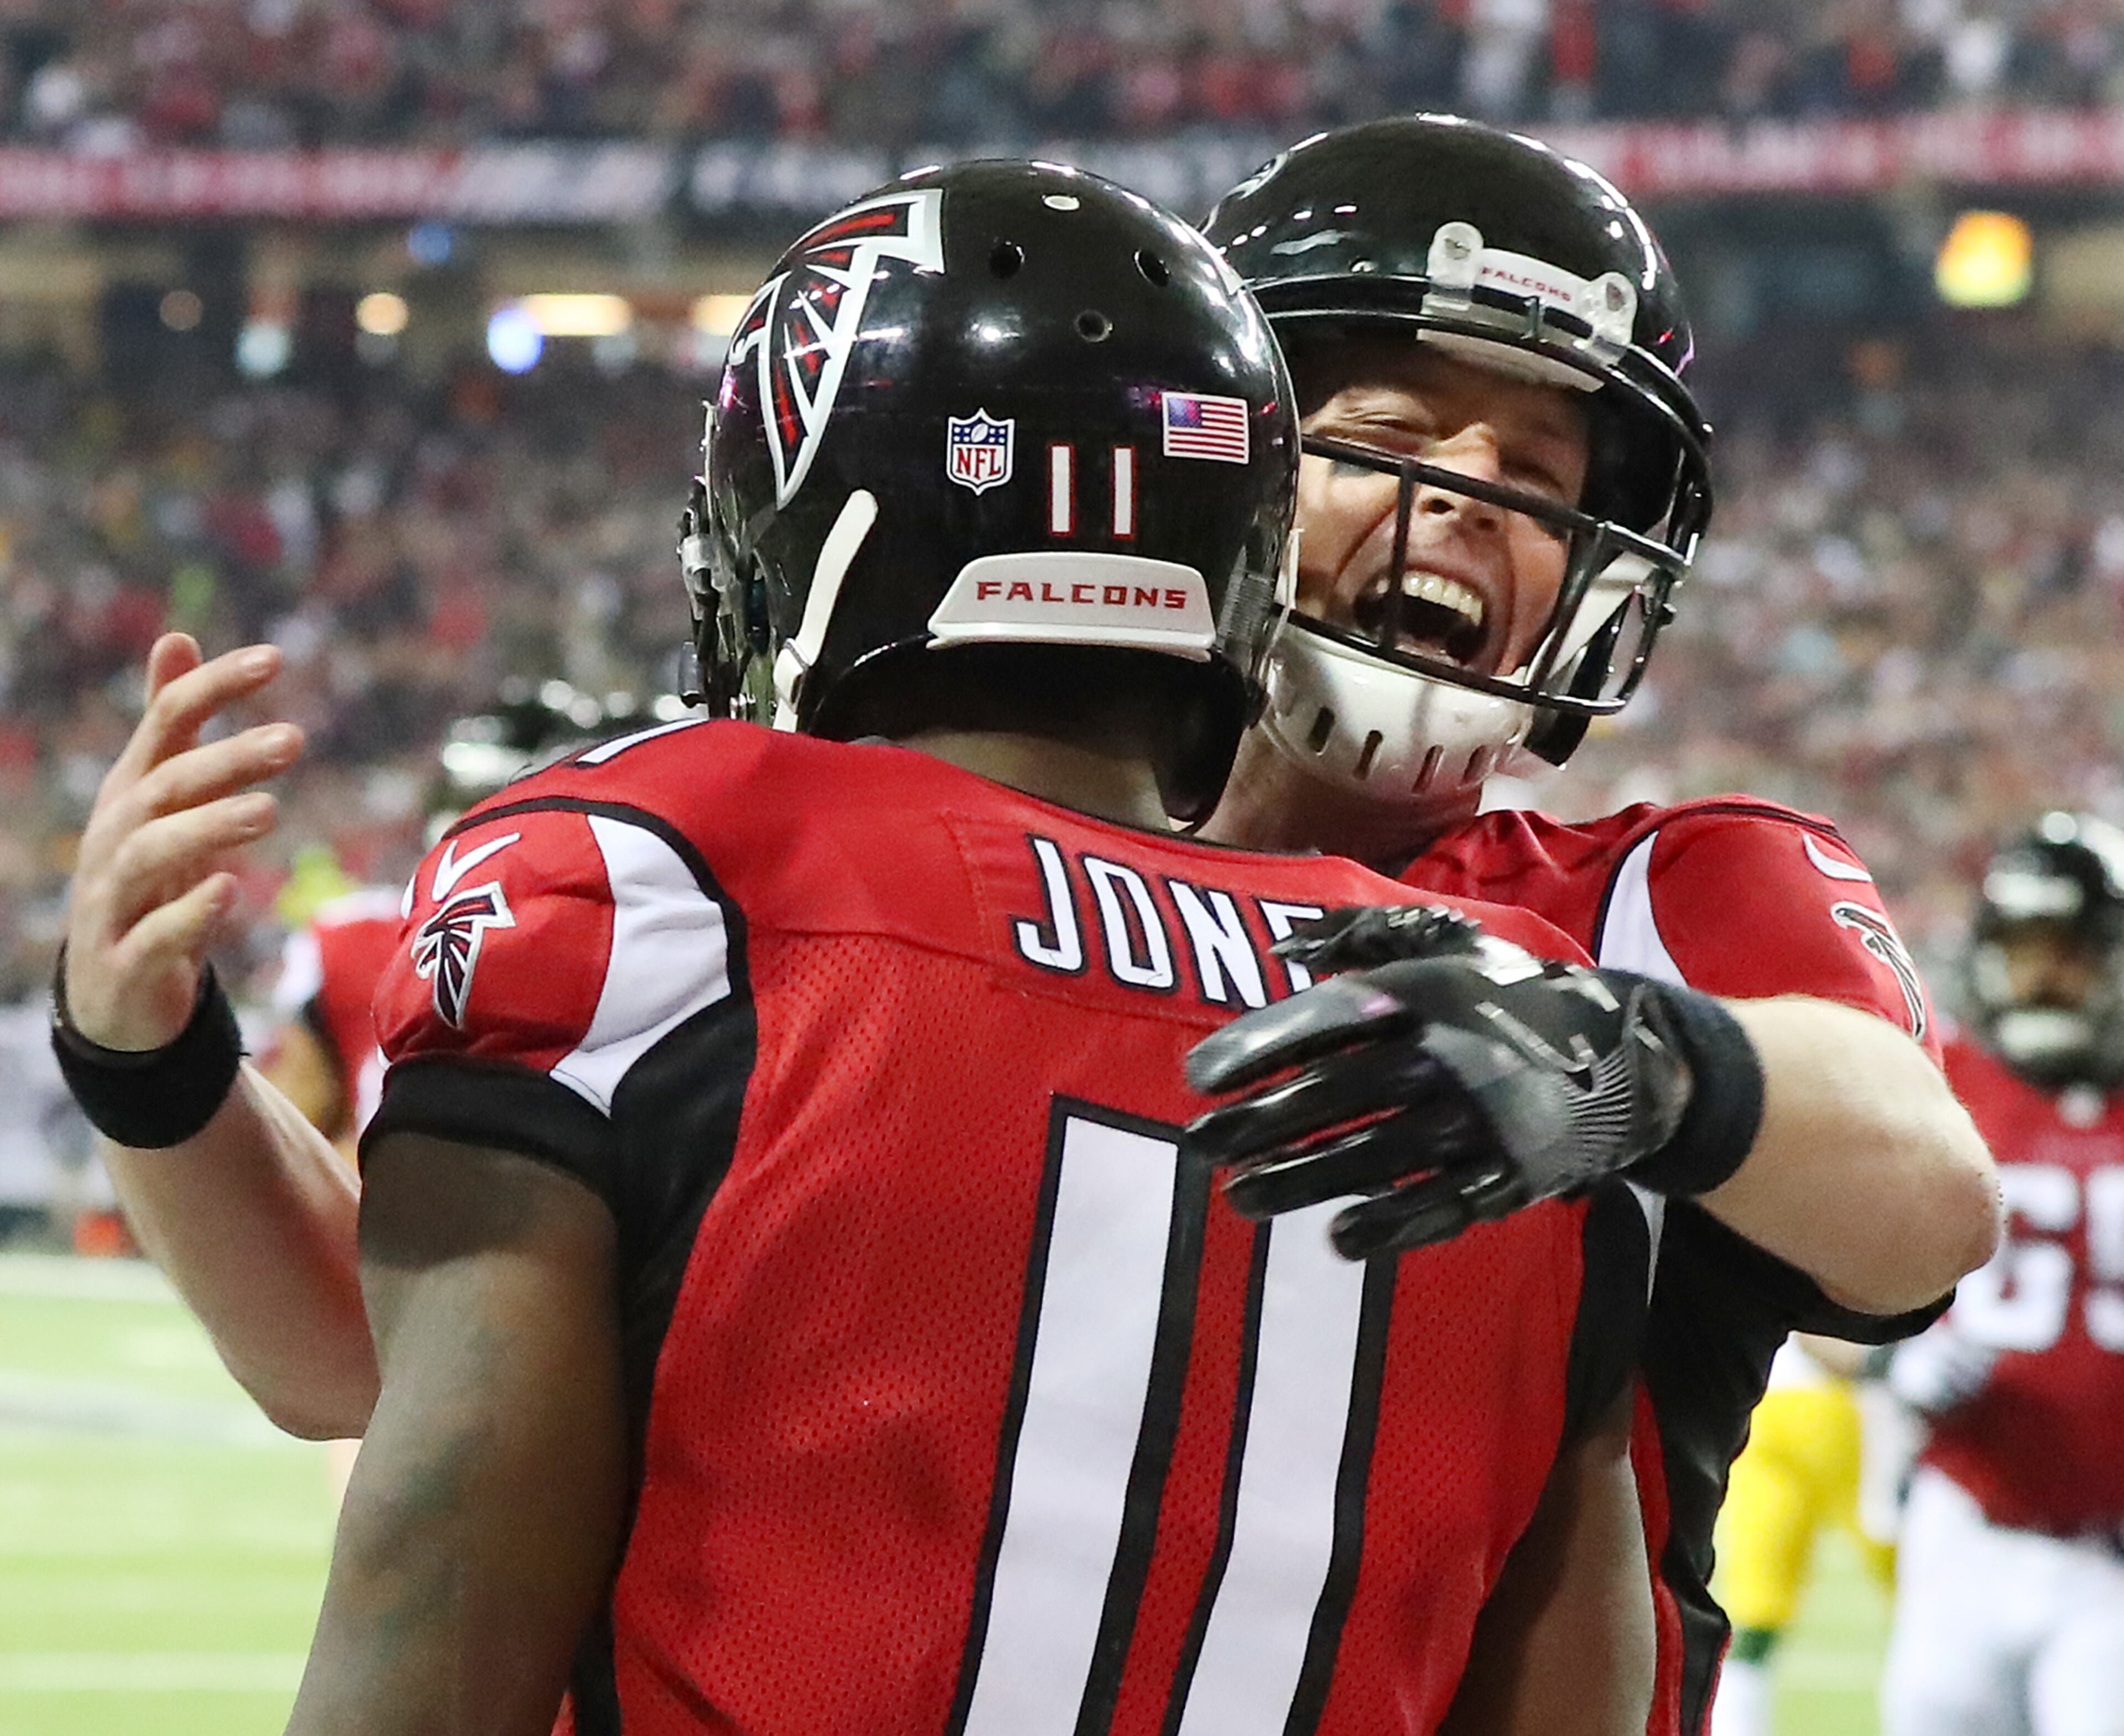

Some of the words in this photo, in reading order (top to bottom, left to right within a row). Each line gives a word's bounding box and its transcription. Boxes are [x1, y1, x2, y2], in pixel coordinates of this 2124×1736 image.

[956, 447, 1002, 479] NFL
[1049, 443, 1137, 538] 11
[977, 581, 1187, 609] FALCONS
[944, 1091, 1401, 1736] 11
